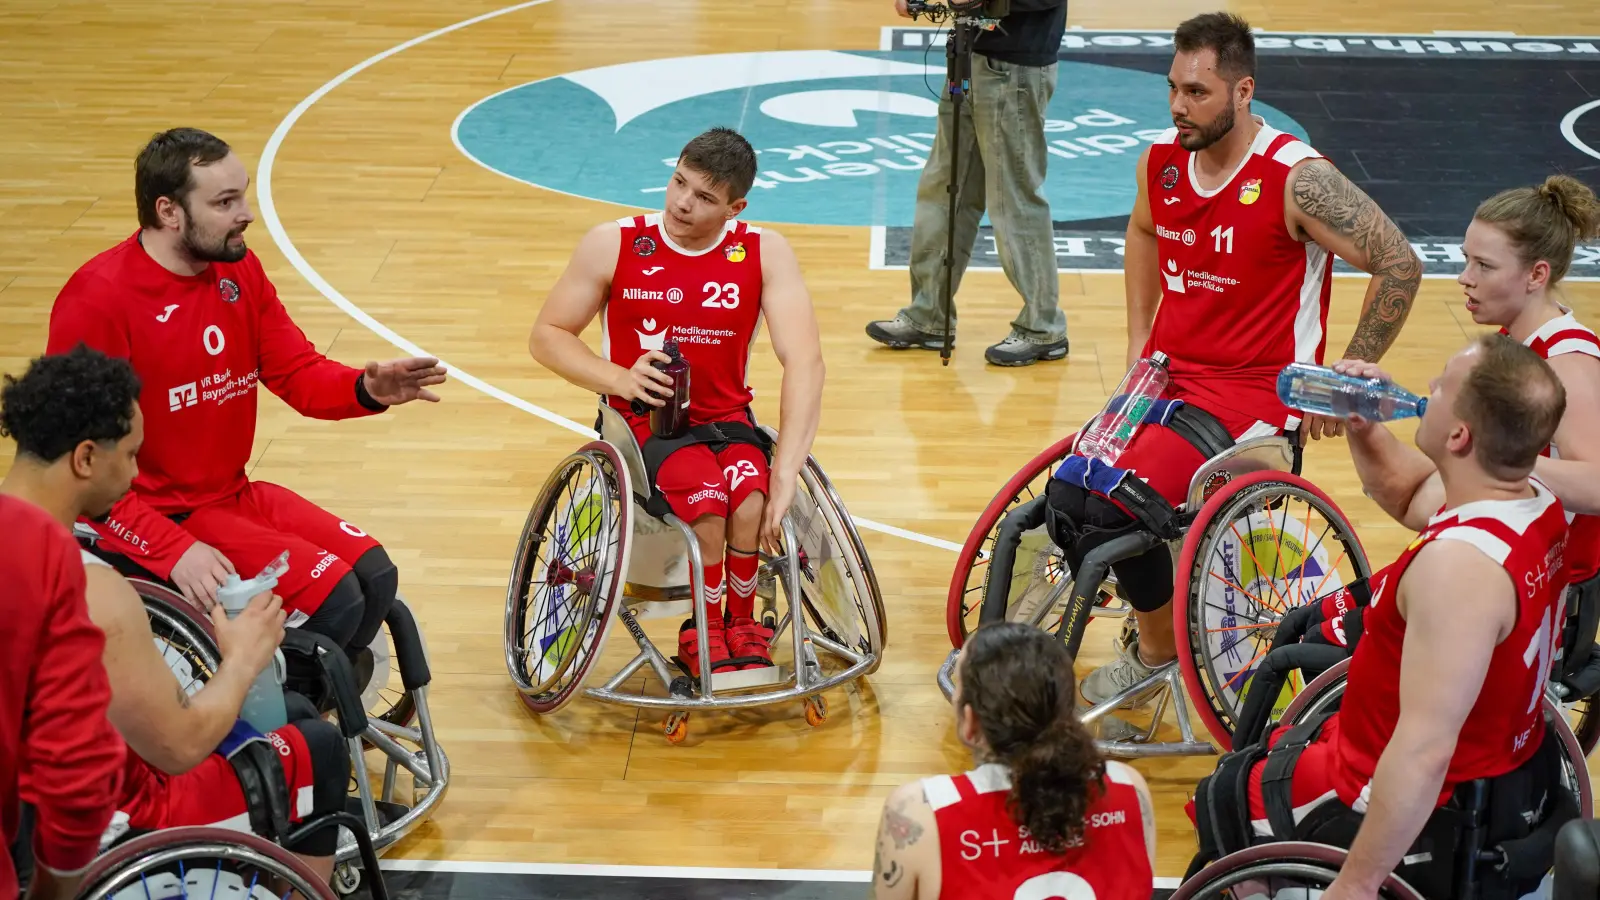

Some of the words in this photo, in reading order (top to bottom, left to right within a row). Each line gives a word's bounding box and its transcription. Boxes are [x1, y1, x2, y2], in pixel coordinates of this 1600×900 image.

[1210, 224, 1234, 254] 11
[1187, 269, 1241, 286] Medikamente-
[622, 287, 664, 300] Allianz
[701, 281, 740, 309] 23
[202, 324, 226, 356] 0
[672, 325, 737, 337] Medikamente-
[200, 376, 212, 389] VR
[213, 367, 231, 384] Bak
[723, 459, 759, 492] 23
[1222, 540, 1238, 628] BECHERT
[620, 611, 646, 643] INVADER
